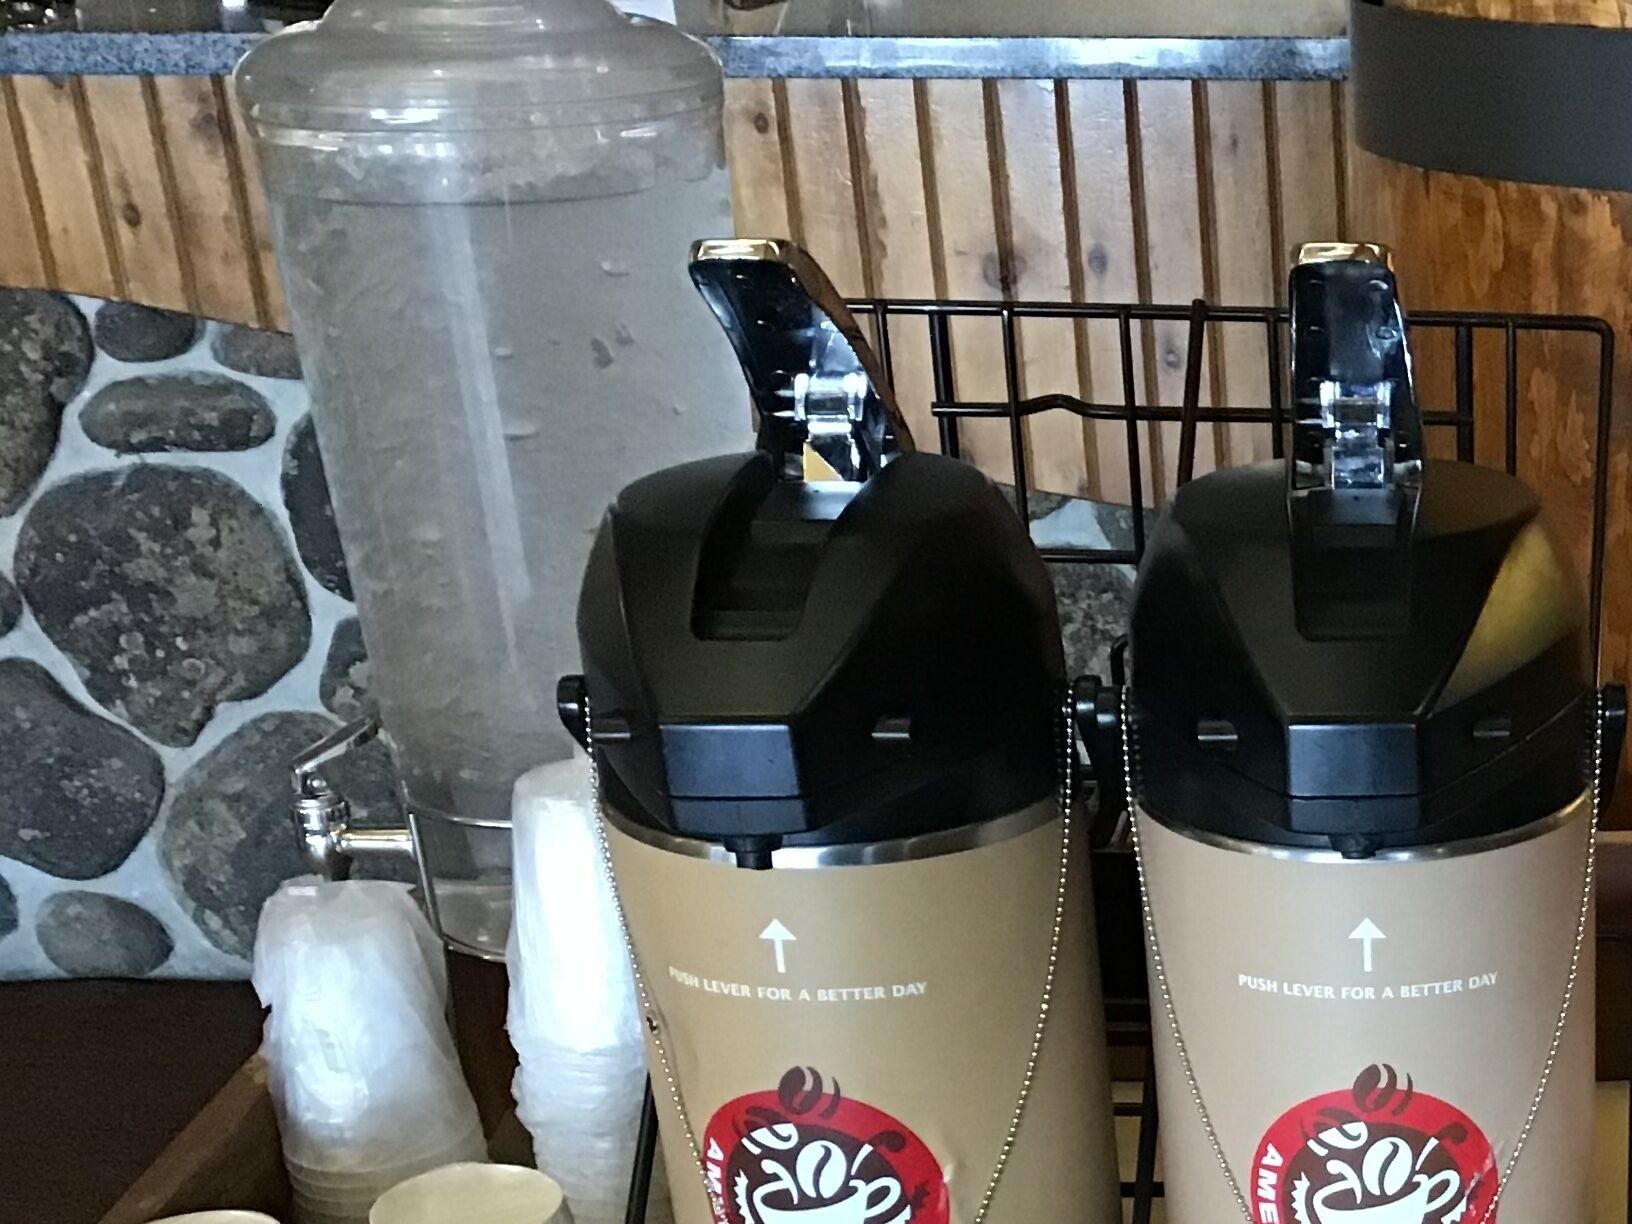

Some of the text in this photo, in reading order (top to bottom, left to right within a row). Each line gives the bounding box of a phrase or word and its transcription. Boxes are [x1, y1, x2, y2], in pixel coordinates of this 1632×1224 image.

[668, 965, 928, 1001] PUSH LEVER FOR A BETTER DAY
[1238, 970, 1498, 1000] PUSH LEVER FOR A BETTER DAY
